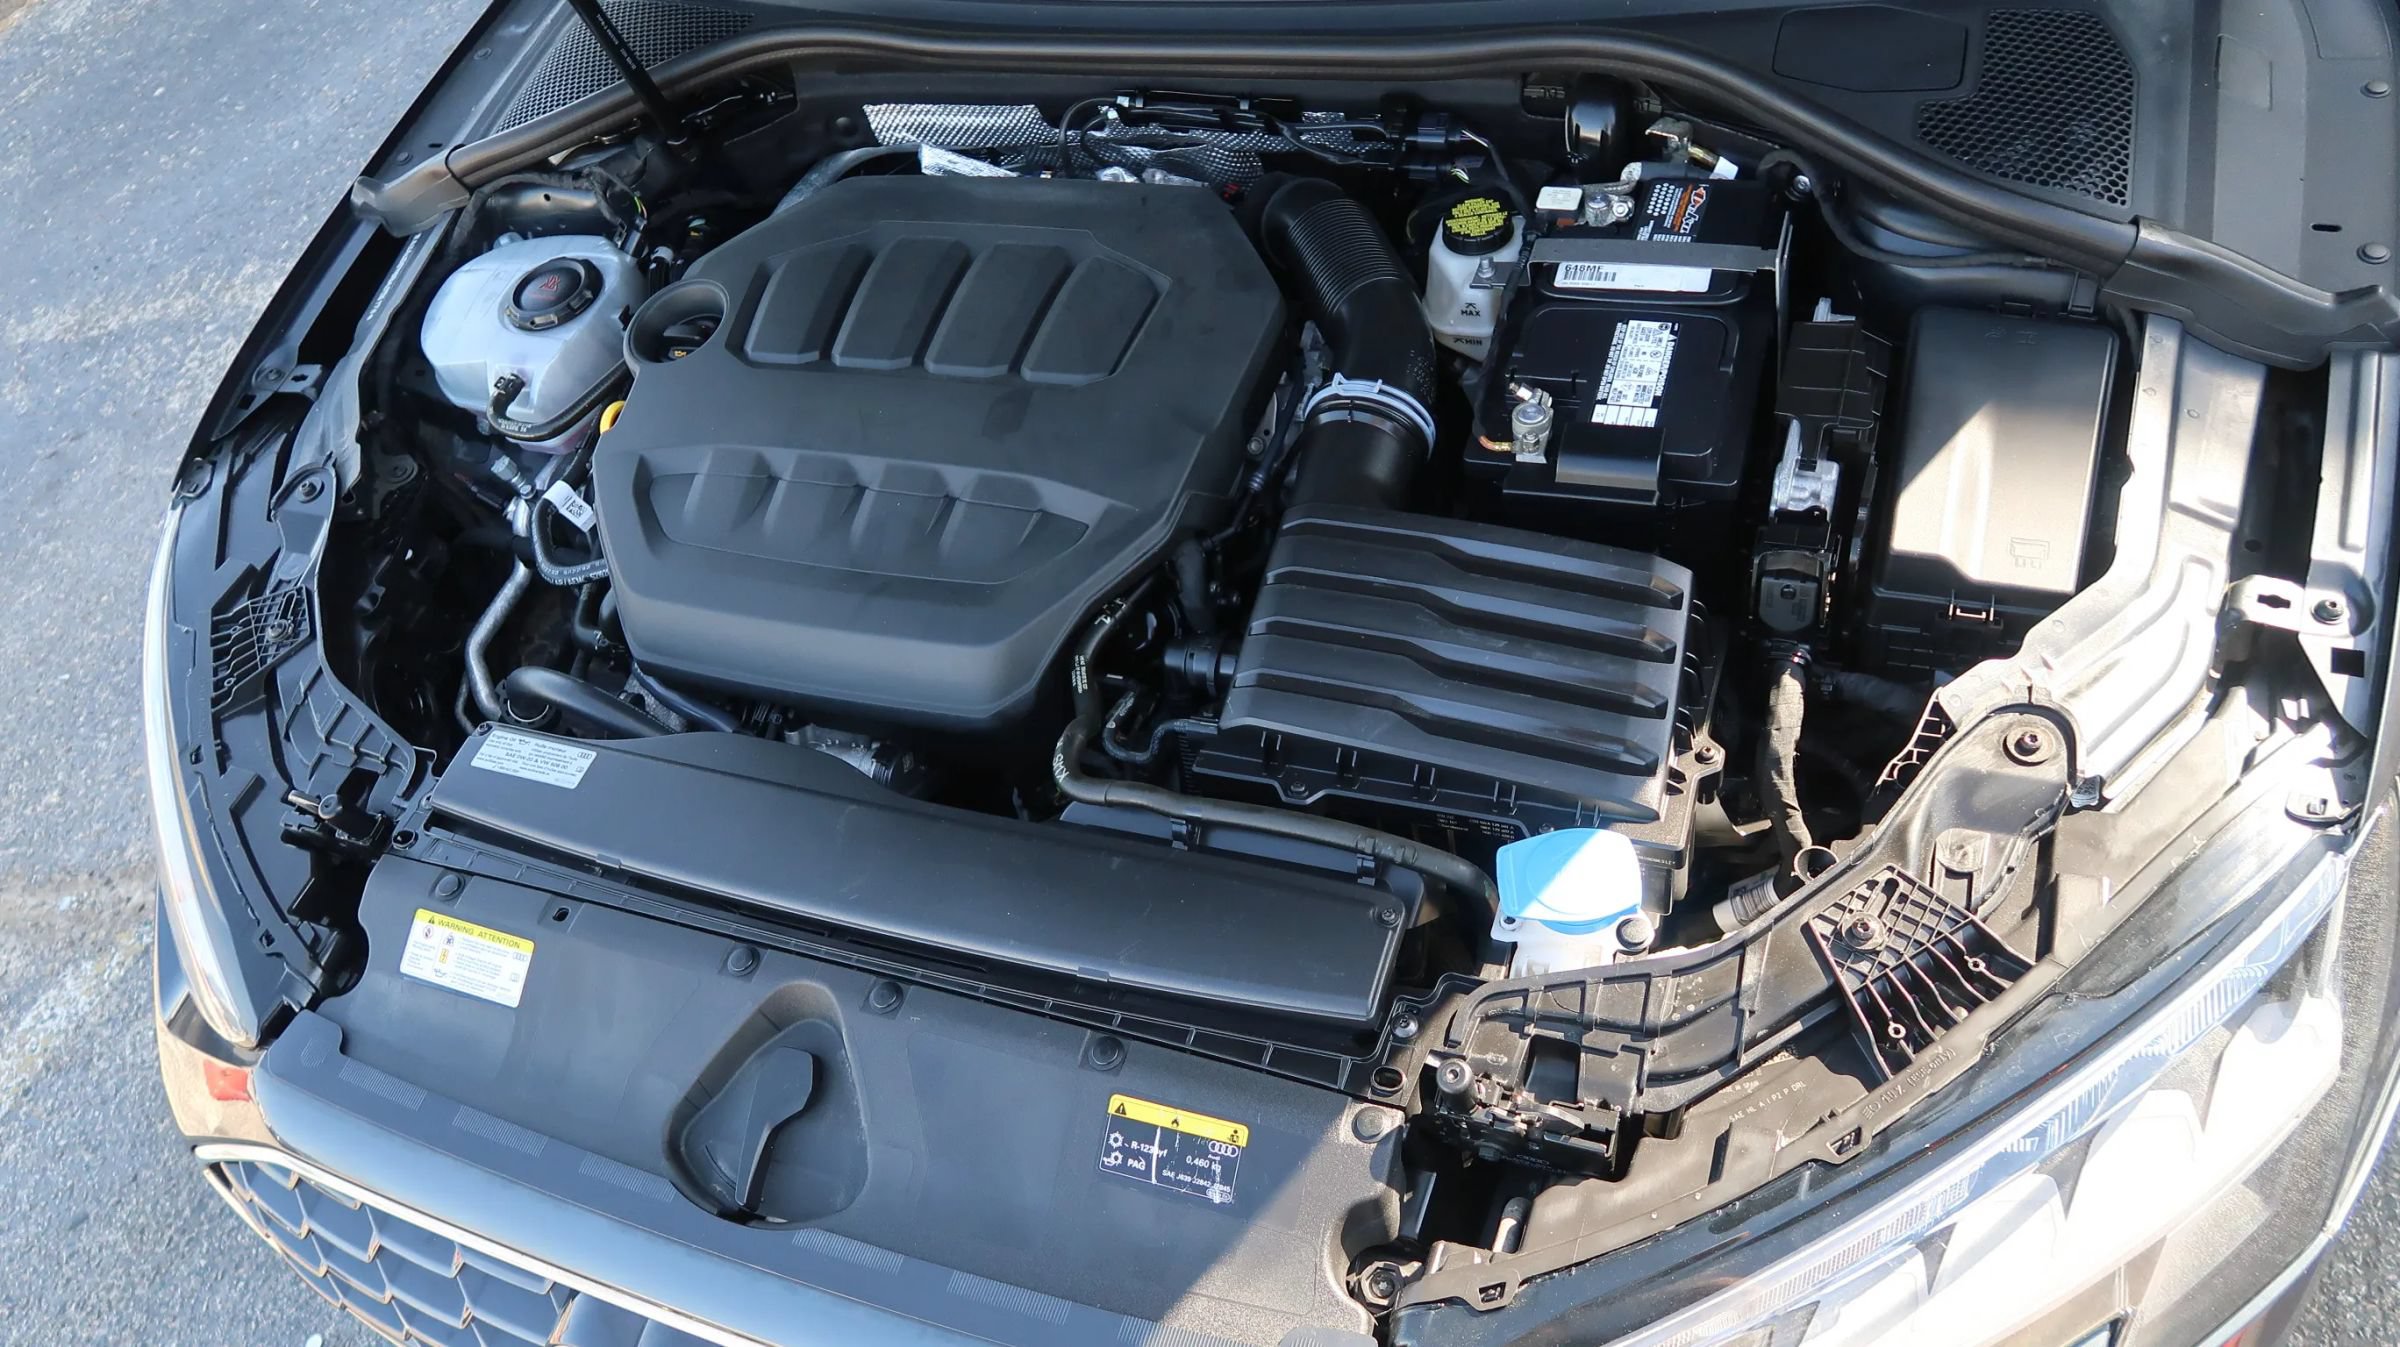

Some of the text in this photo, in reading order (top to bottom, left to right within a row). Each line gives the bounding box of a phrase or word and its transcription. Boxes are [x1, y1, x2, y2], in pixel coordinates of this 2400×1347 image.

[1461, 309, 1481, 317] MAX
[1465, 338, 1482, 346] MIN
[438, 918, 520, 949] WARNING ATTENTION
[1728, 1110, 1745, 1123] SAE
[1130, 1140, 1168, 1158] R-123yf
[1127, 1158, 1146, 1171] PAG
[1185, 1155, 1210, 1169] 0,460
[1161, 1169, 1176, 1178] SAE
